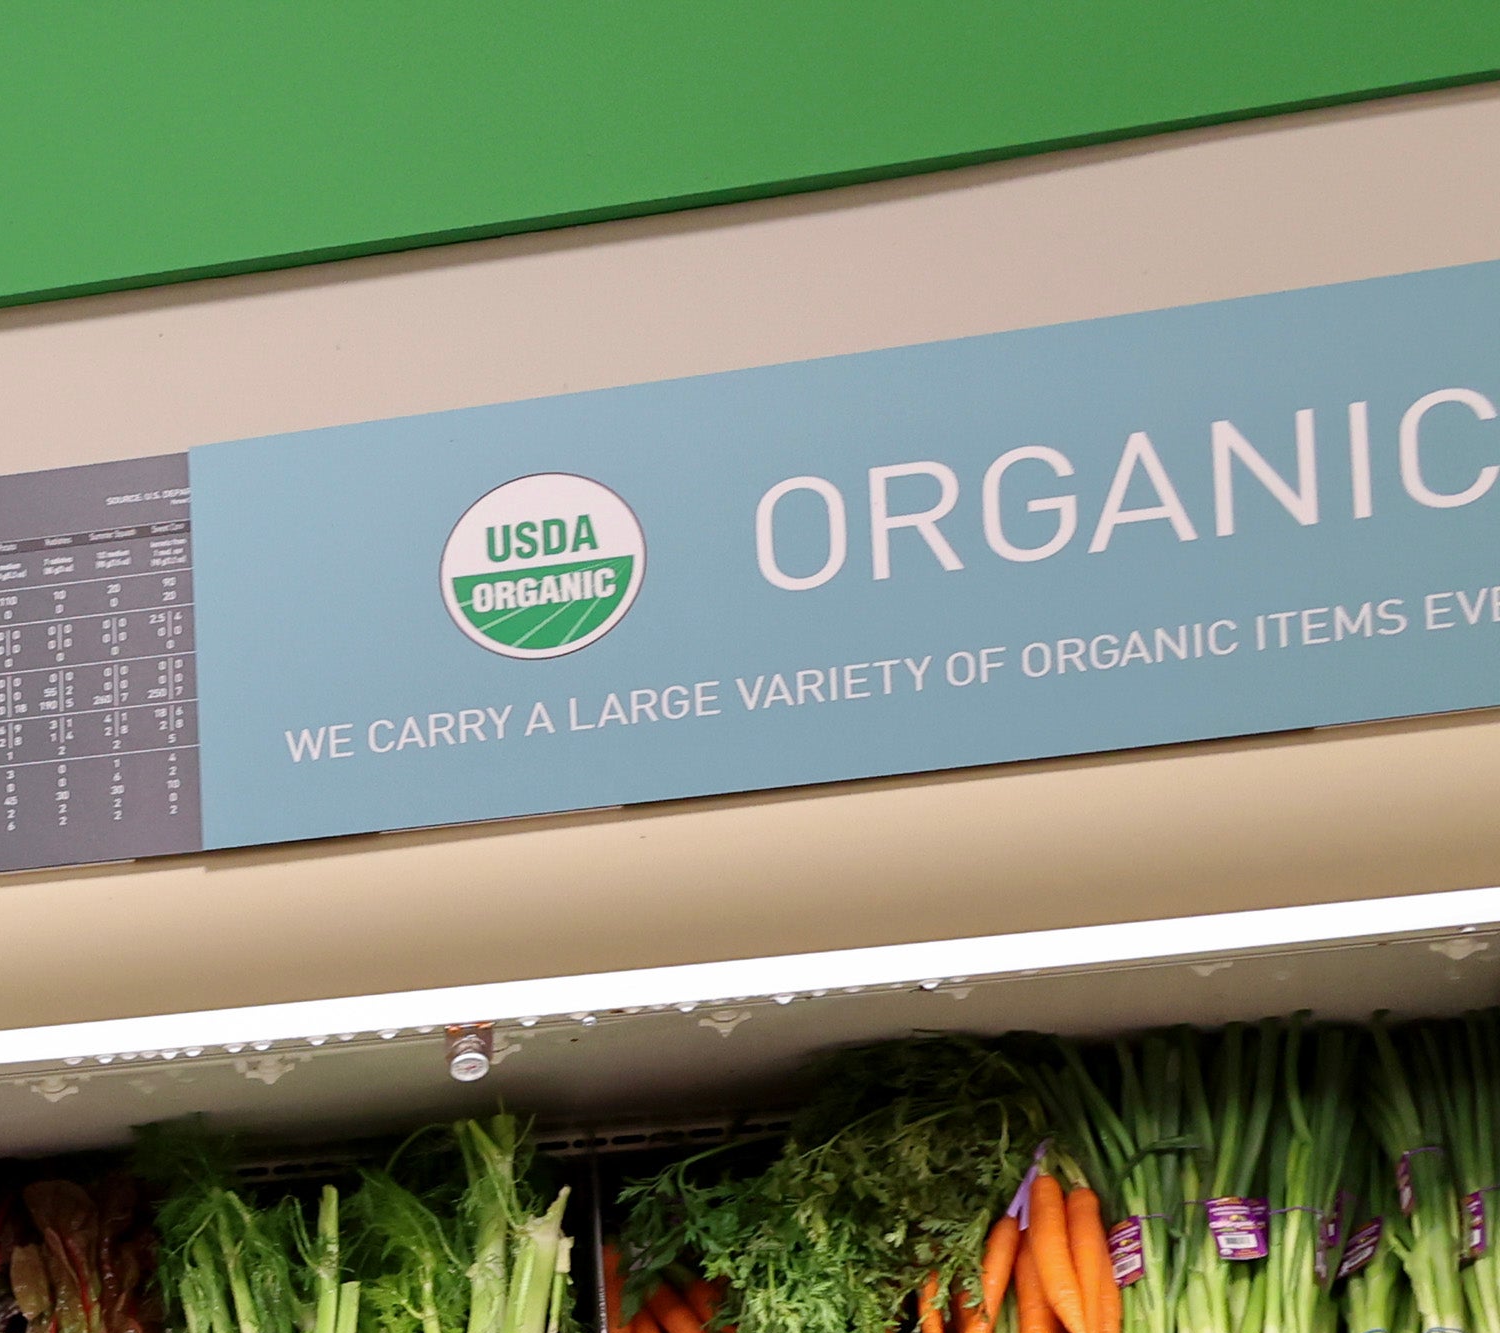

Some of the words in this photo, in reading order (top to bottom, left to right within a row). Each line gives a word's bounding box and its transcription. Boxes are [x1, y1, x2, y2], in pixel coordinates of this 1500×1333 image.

[487, 514, 599, 563] USDA
[756, 387, 1500, 591] ORGANIC
[471, 567, 617, 613] ORGANIC
[284, 722, 355, 763] WE
[368, 704, 513, 753] CARRY
[524, 701, 556, 737] A
[569, 680, 722, 731] LARGE
[735, 655, 932, 711] VARIETY
[946, 646, 1006, 687] OF
[1021, 619, 1238, 678] ORGANIC
[1256, 598, 1408, 651] ITEMS
